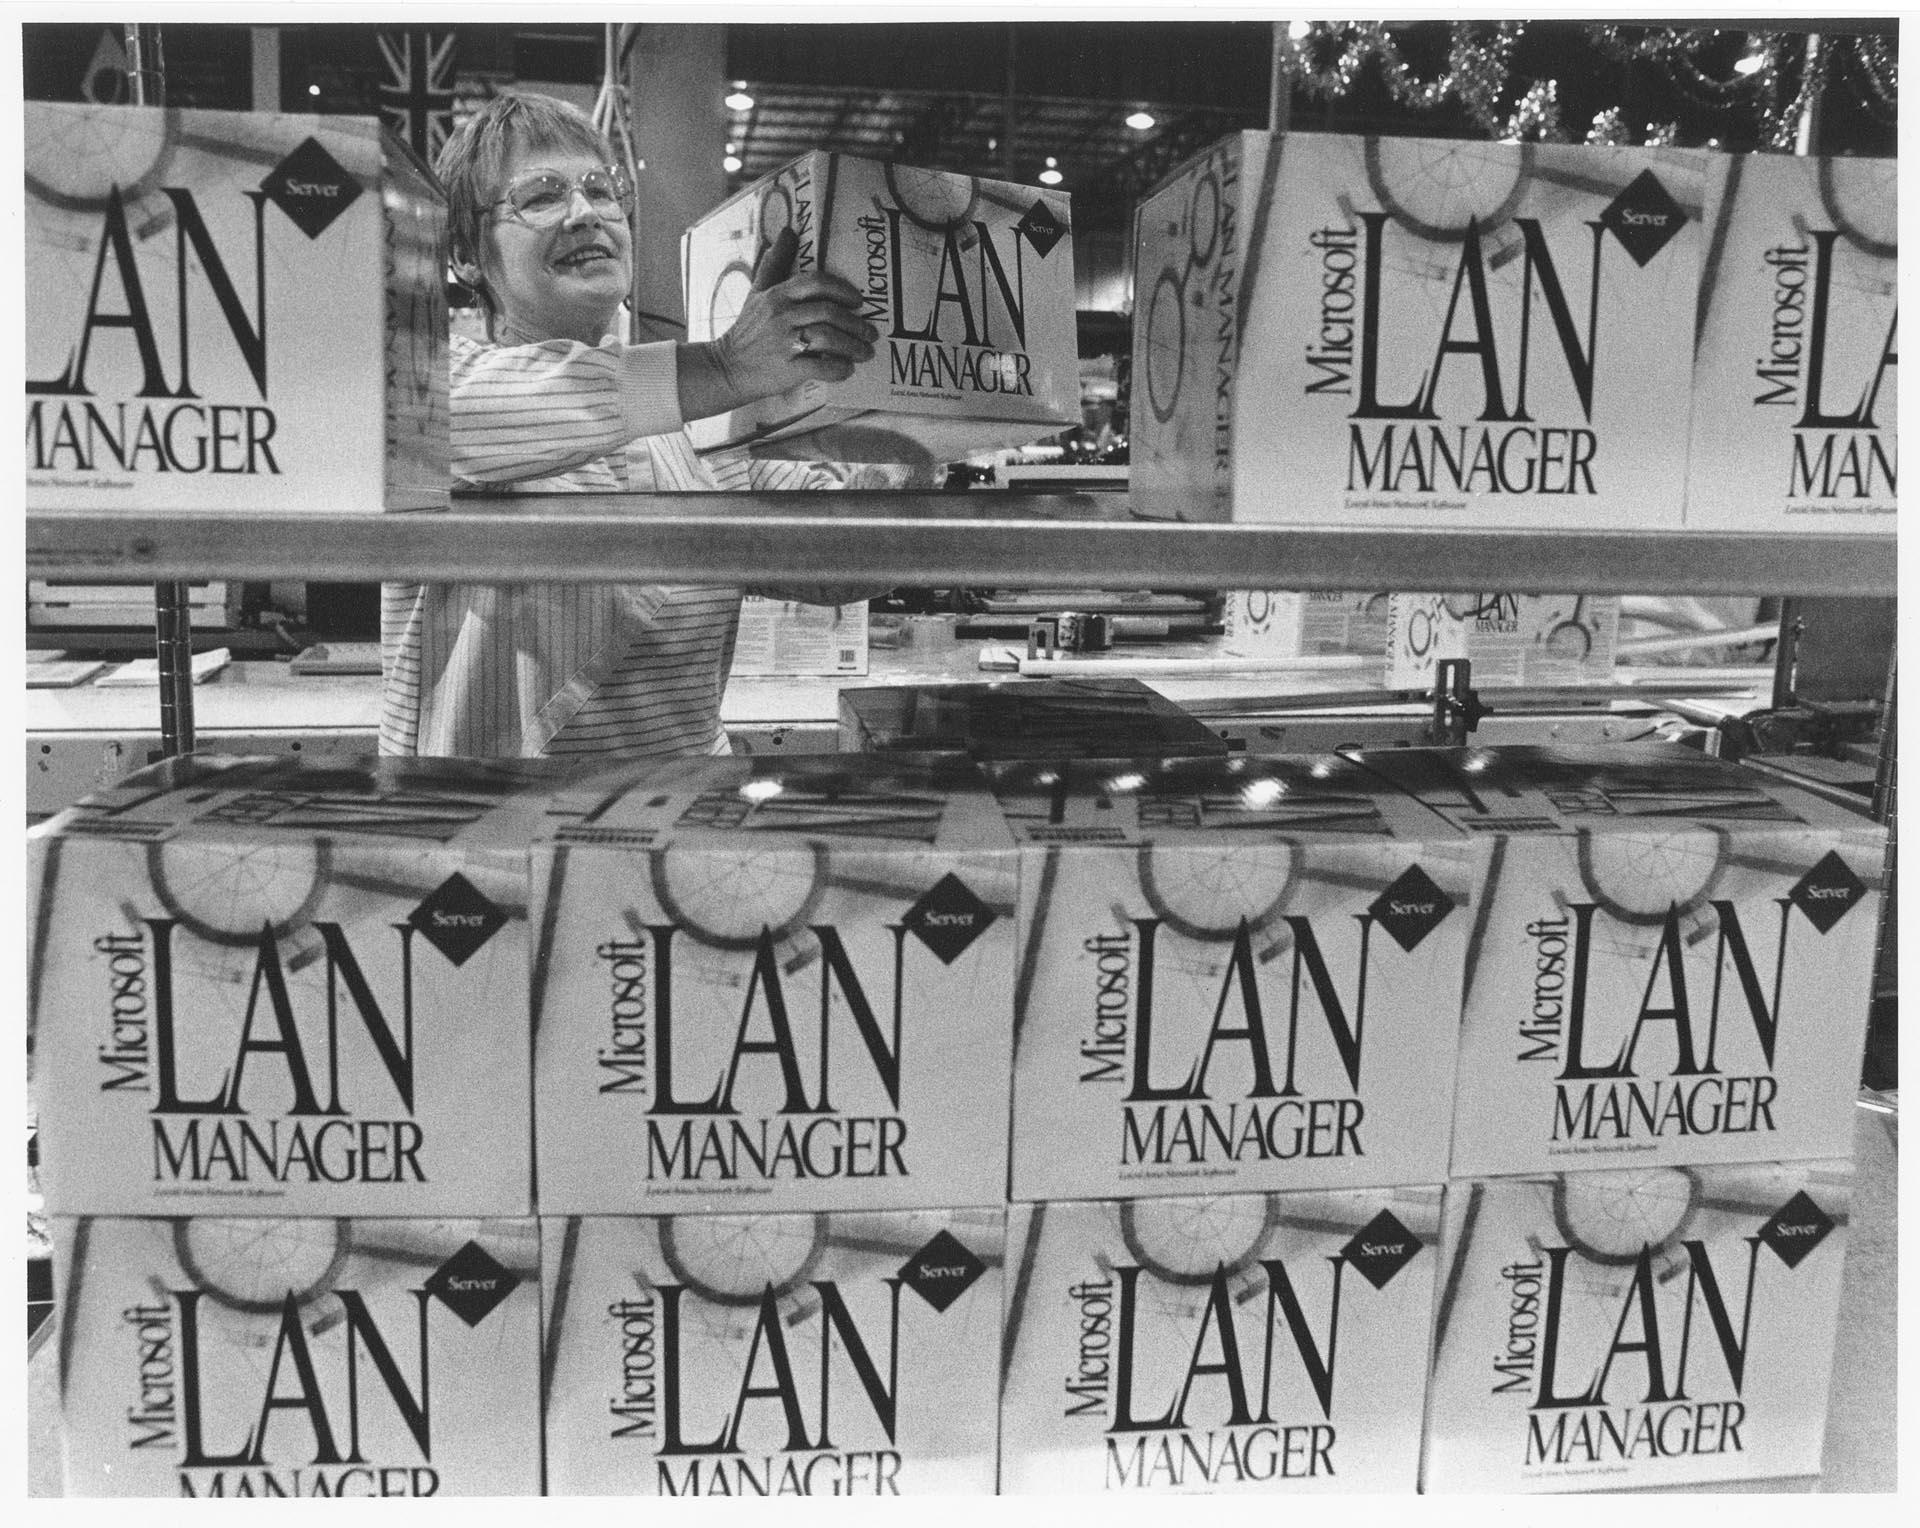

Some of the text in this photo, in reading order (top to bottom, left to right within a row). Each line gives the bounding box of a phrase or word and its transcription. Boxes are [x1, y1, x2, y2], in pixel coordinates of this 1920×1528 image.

[286, 177, 340, 198] Server
[1029, 221, 1056, 236] Server
[1622, 208, 1668, 226] Server
[26, 182, 269, 401] AN
[861, 213, 890, 323] Microsoft
[885, 207, 1027, 352] LAN
[1305, 225, 1357, 395] Microsoft
[1347, 212, 1603, 423] LAN
[1753, 243, 1809, 406] Microsoft
[888, 340, 1035, 397] MANAGER
[1346, 424, 1599, 494] MANAGER
[431, 908, 485, 928] Server
[924, 908, 975, 928] Server
[1390, 899, 1435, 916] Server
[1807, 884, 1850, 902] Server
[94, 930, 151, 1093] Microsoft
[143, 918, 416, 1117] LAN
[597, 940, 648, 1095] Microsoft
[644, 923, 906, 1114] LAN
[1079, 930, 1131, 1084] Microsoft
[1122, 914, 1372, 1101] LAN
[1517, 915, 1570, 1063] Microsoft
[1554, 899, 1794, 1080] LAN
[151, 1117, 429, 1183] MANAGER
[644, 1117, 910, 1181] MANAGER
[1120, 1099, 1365, 1165] MANAGER
[1549, 1076, 1778, 1141] MANAGER
[447, 1273, 498, 1293] Server
[918, 1261, 969, 1281] Server
[1360, 1241, 1405, 1257] Server
[121, 1300, 178, 1452] Microsoft
[168, 1288, 433, 1467] LAN
[606, 1297, 656, 1441] Microsoft
[653, 1277, 904, 1457] LAN
[1064, 1275, 1114, 1418] Microsoft
[1105, 1256, 1346, 1433] LAN
[1491, 1258, 1545, 1396] Microsoft
[1527, 1236, 1763, 1410] LAN
[654, 1450, 904, 1497] MANAGER
[1102, 1424, 1336, 1490] MANAGER
[1525, 1400, 1747, 1466] MANAGER
